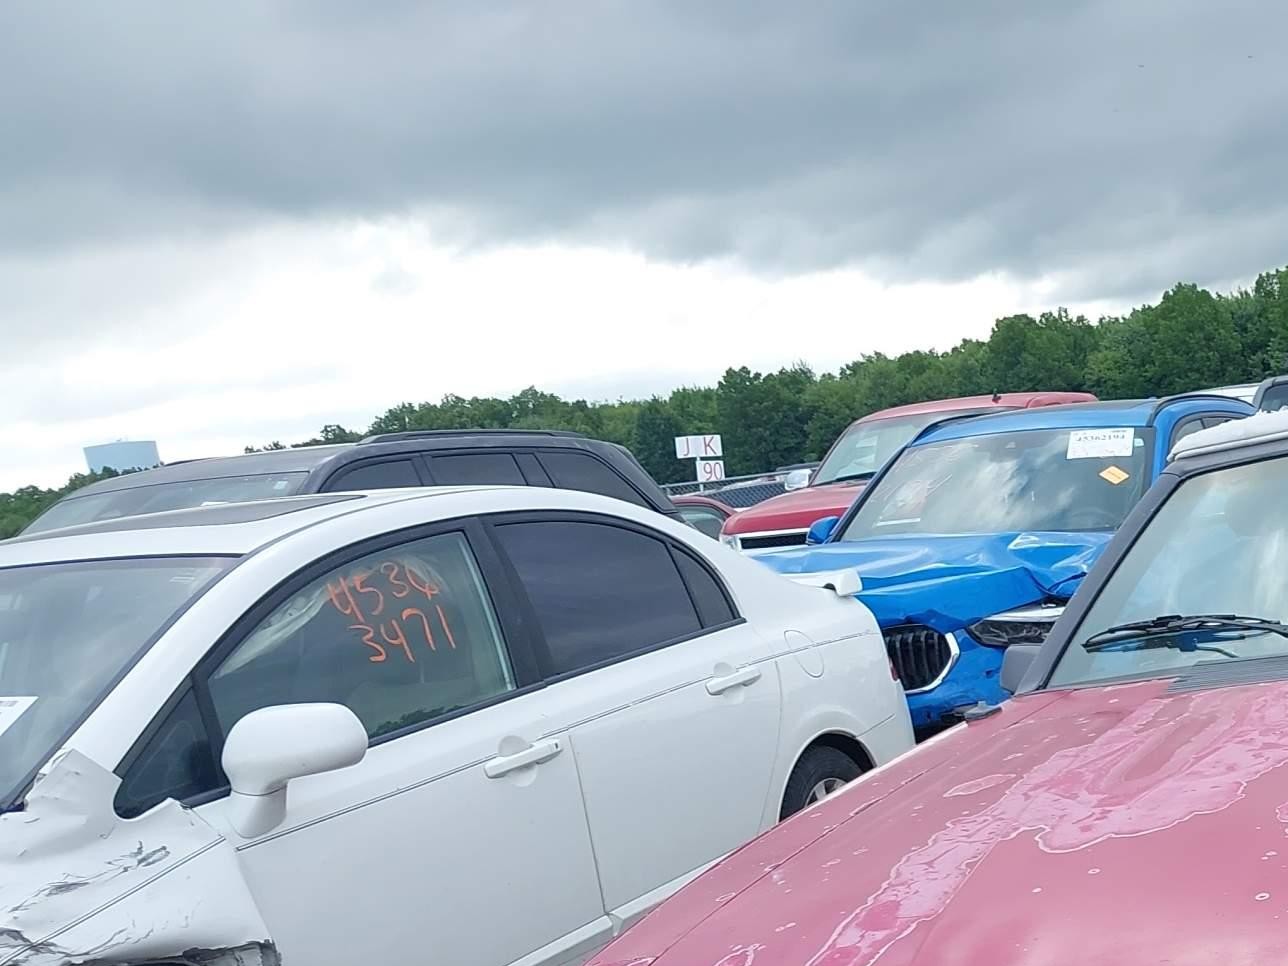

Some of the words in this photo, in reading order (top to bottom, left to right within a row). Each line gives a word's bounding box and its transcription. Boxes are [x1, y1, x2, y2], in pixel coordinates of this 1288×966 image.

[683, 437, 690, 457] J
[703, 436, 717, 455] K
[703, 461, 723, 481] 90
[347, 604, 456, 663] 3471
